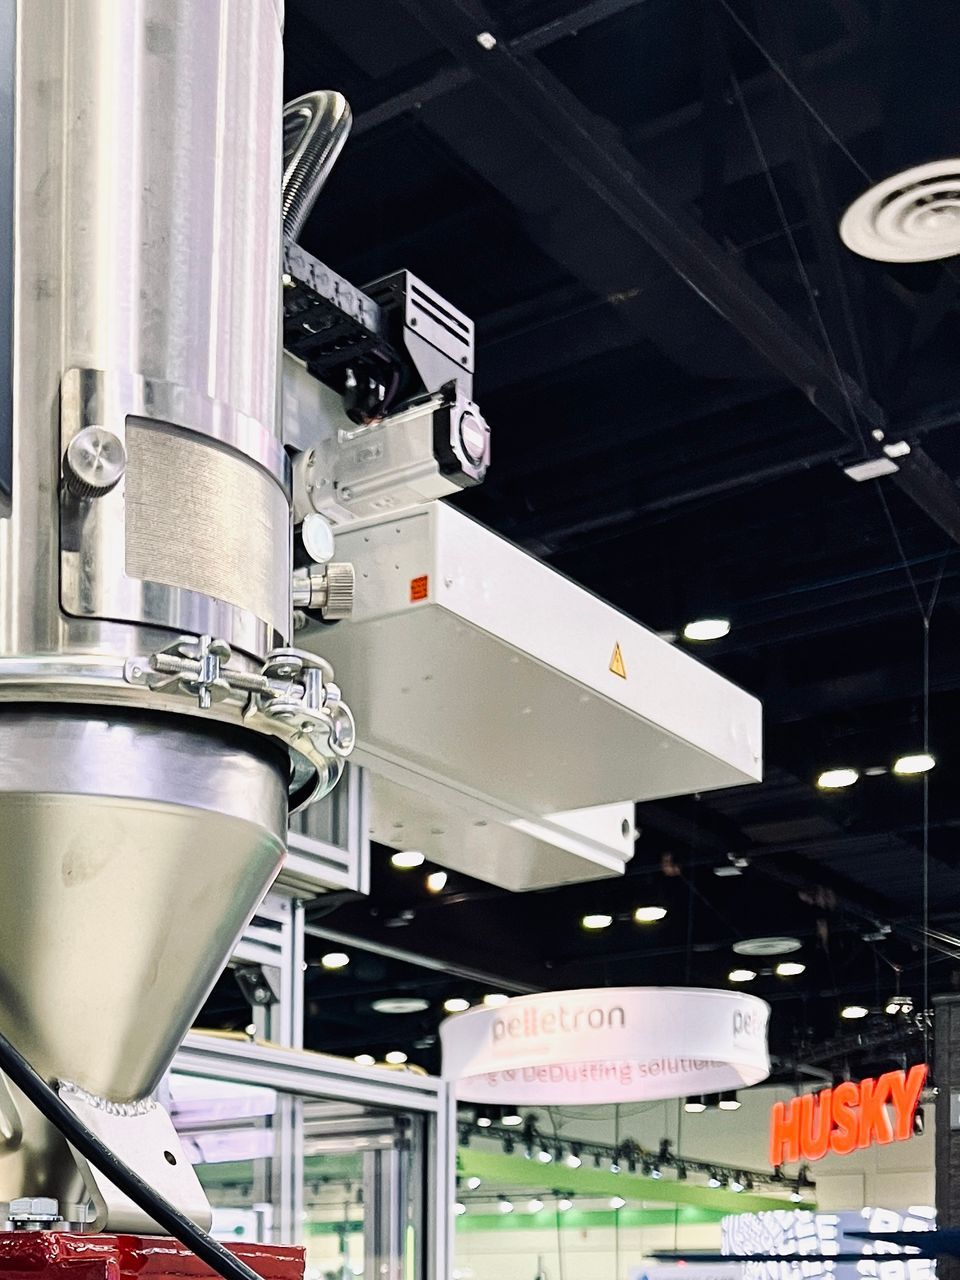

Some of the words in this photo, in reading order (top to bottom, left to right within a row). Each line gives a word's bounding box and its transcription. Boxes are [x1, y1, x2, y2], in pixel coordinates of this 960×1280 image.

[491, 1004, 625, 1043] pelletron
[522, 1061, 632, 1086] DeDusting
[769, 1063, 929, 1167] HUSKY
